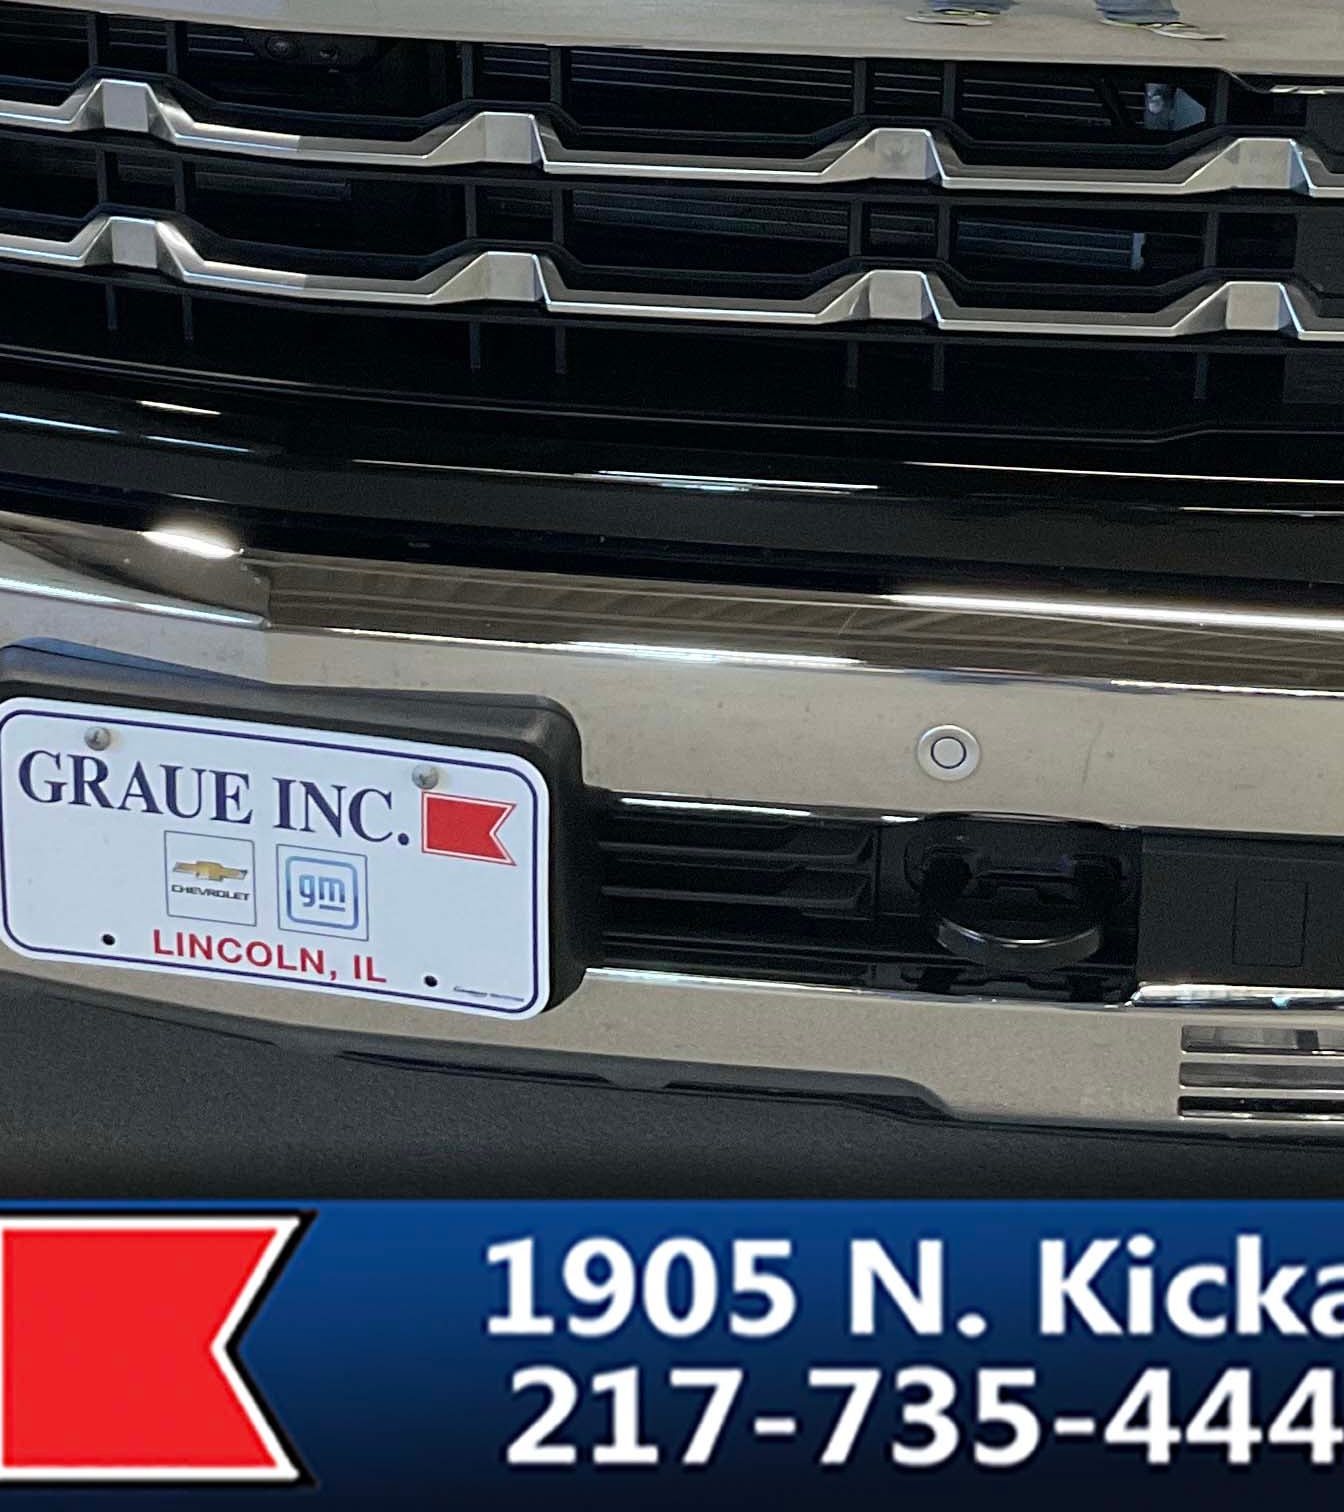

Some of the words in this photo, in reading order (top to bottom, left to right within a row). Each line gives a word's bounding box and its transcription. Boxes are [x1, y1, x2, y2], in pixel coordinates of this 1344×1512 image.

[18, 749, 254, 825] GRAUE
[273, 776, 410, 847] INC.
[171, 884, 251, 902] CHEVROLET
[298, 874, 346, 913] gm
[153, 929, 338, 983] LINCOLN,
[353, 955, 388, 984] IL
